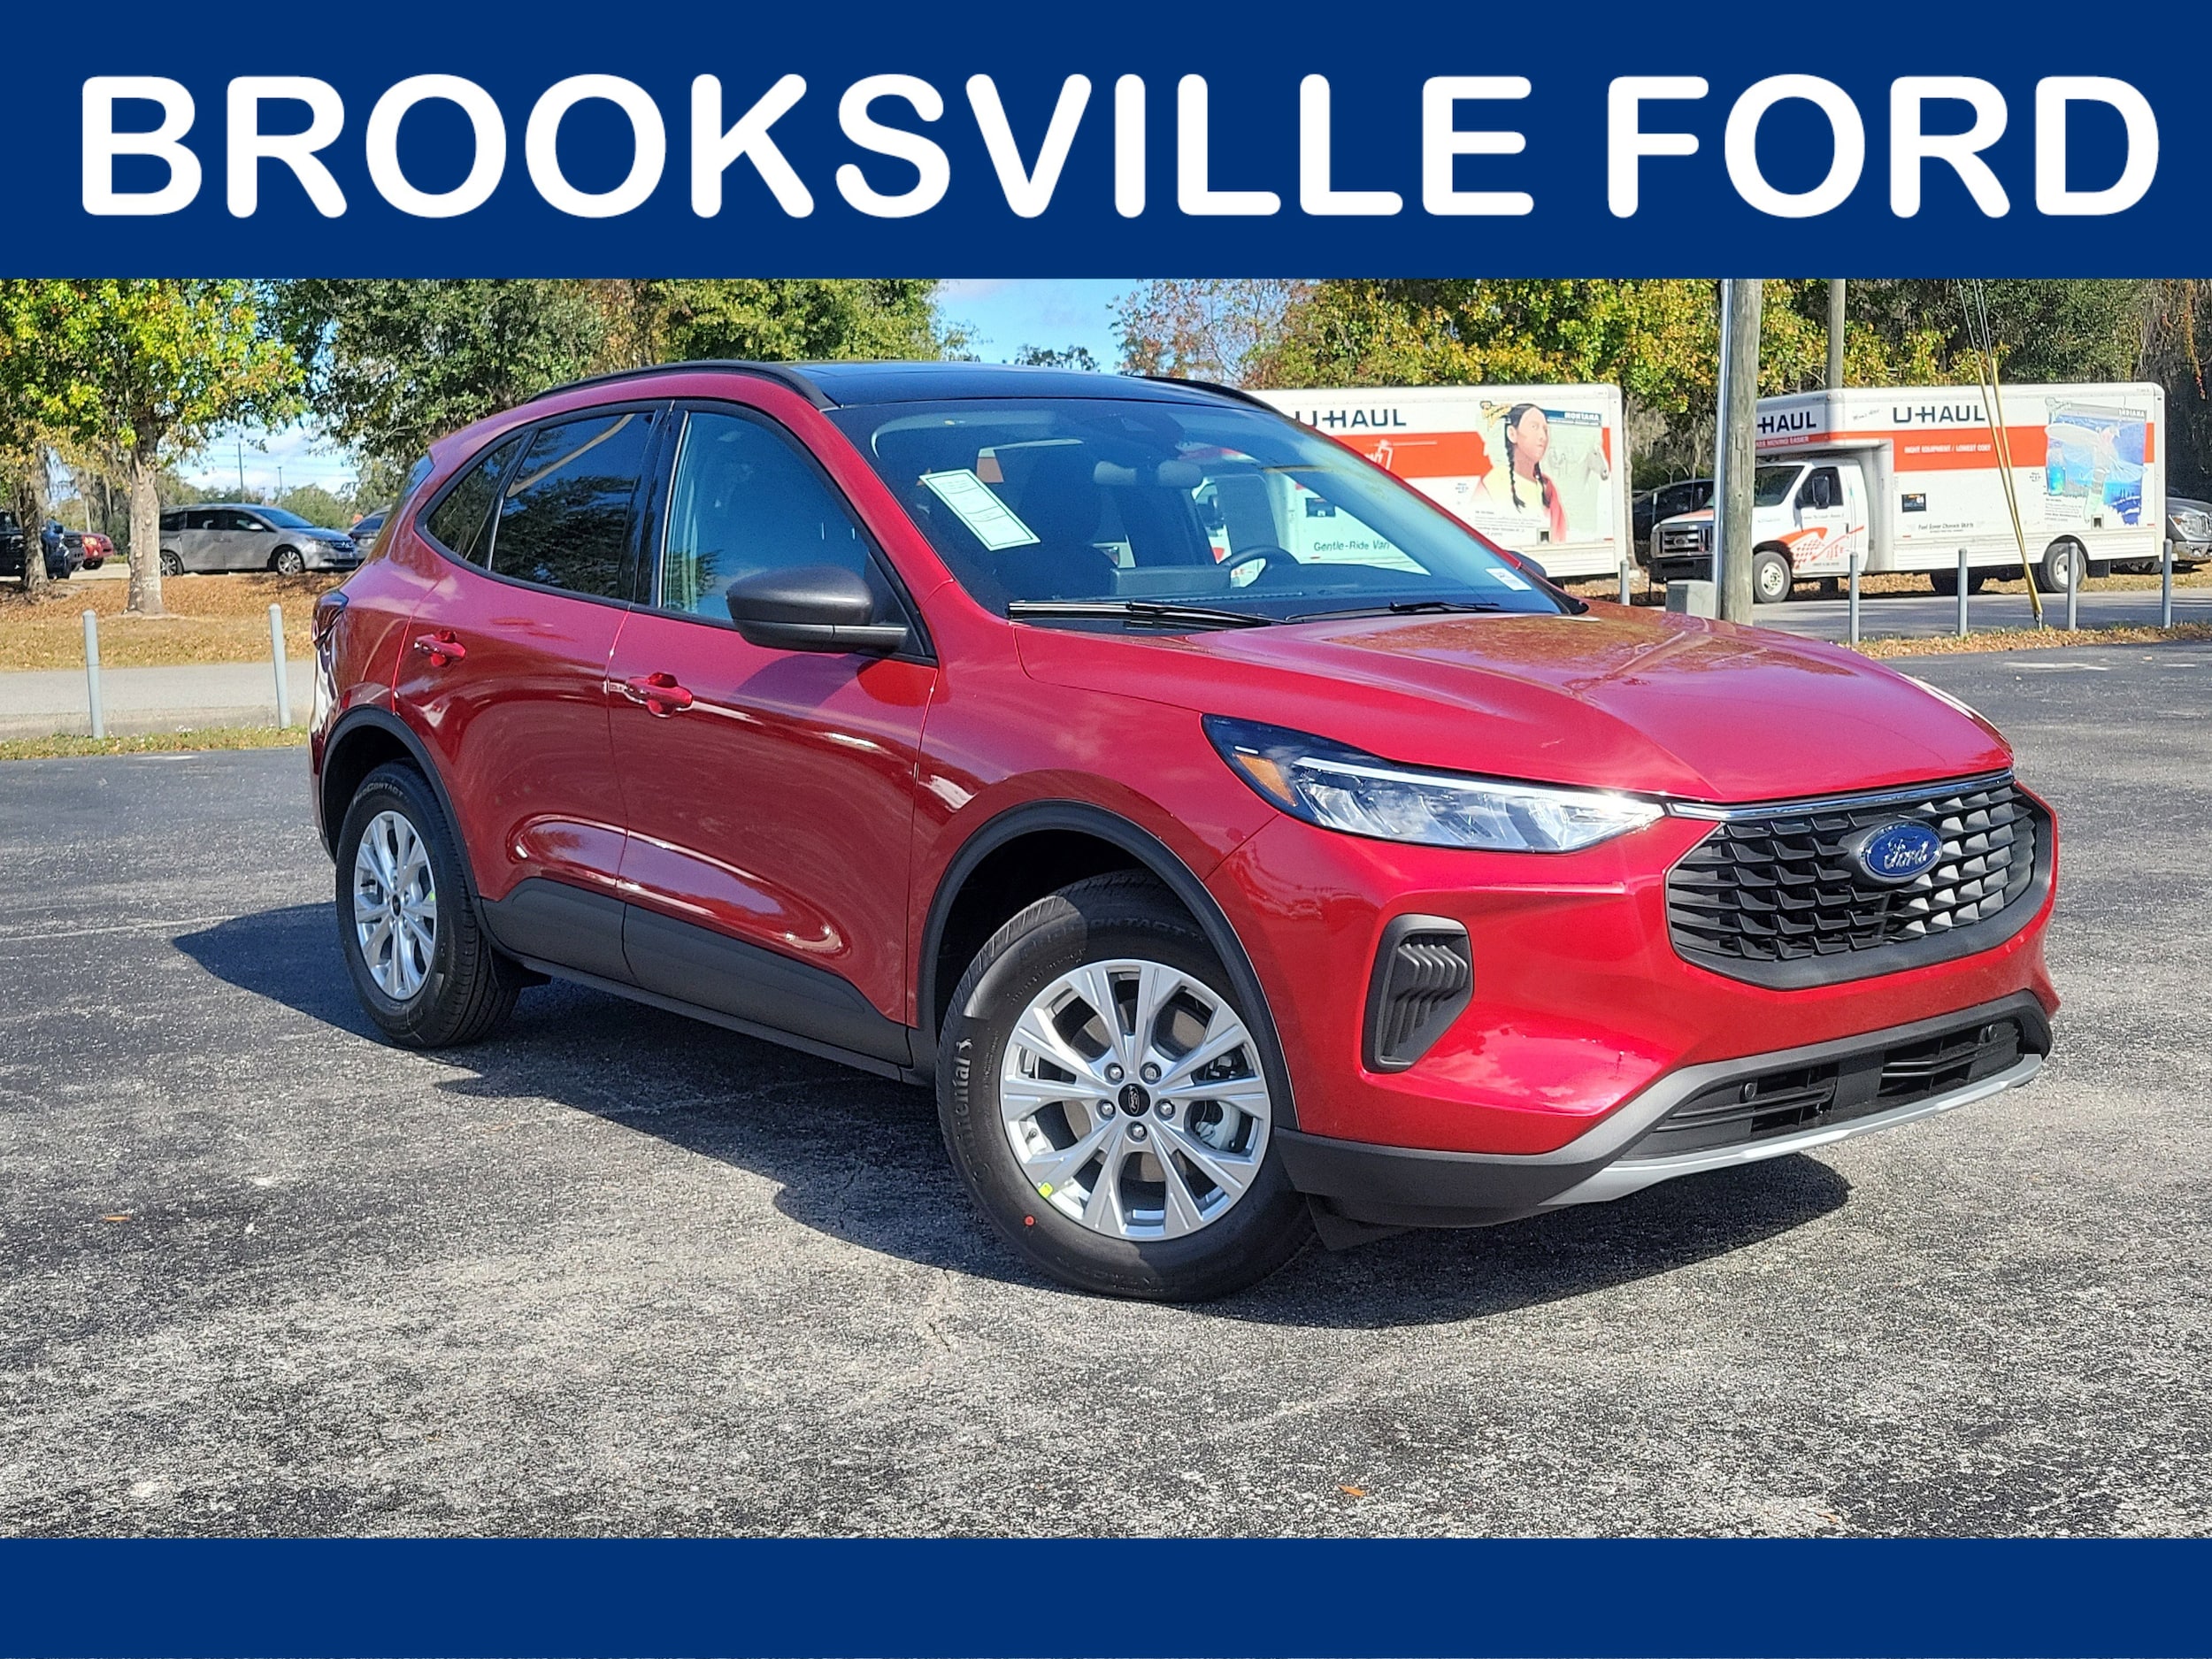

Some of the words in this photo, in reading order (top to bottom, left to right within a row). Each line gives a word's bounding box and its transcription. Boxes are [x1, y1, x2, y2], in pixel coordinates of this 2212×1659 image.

[1295, 409, 1407, 428] U-HAUL
[1564, 412, 1599, 421] MONTANA
[1757, 411, 1816, 434] -HAUL
[1893, 404, 1985, 423] U-HAUL
[2118, 409, 2145, 418] INDIANA
[1314, 541, 1370, 552] Gentle-Ride
[1373, 540, 1390, 550] Van
[1884, 835, 1930, 870] Ford
